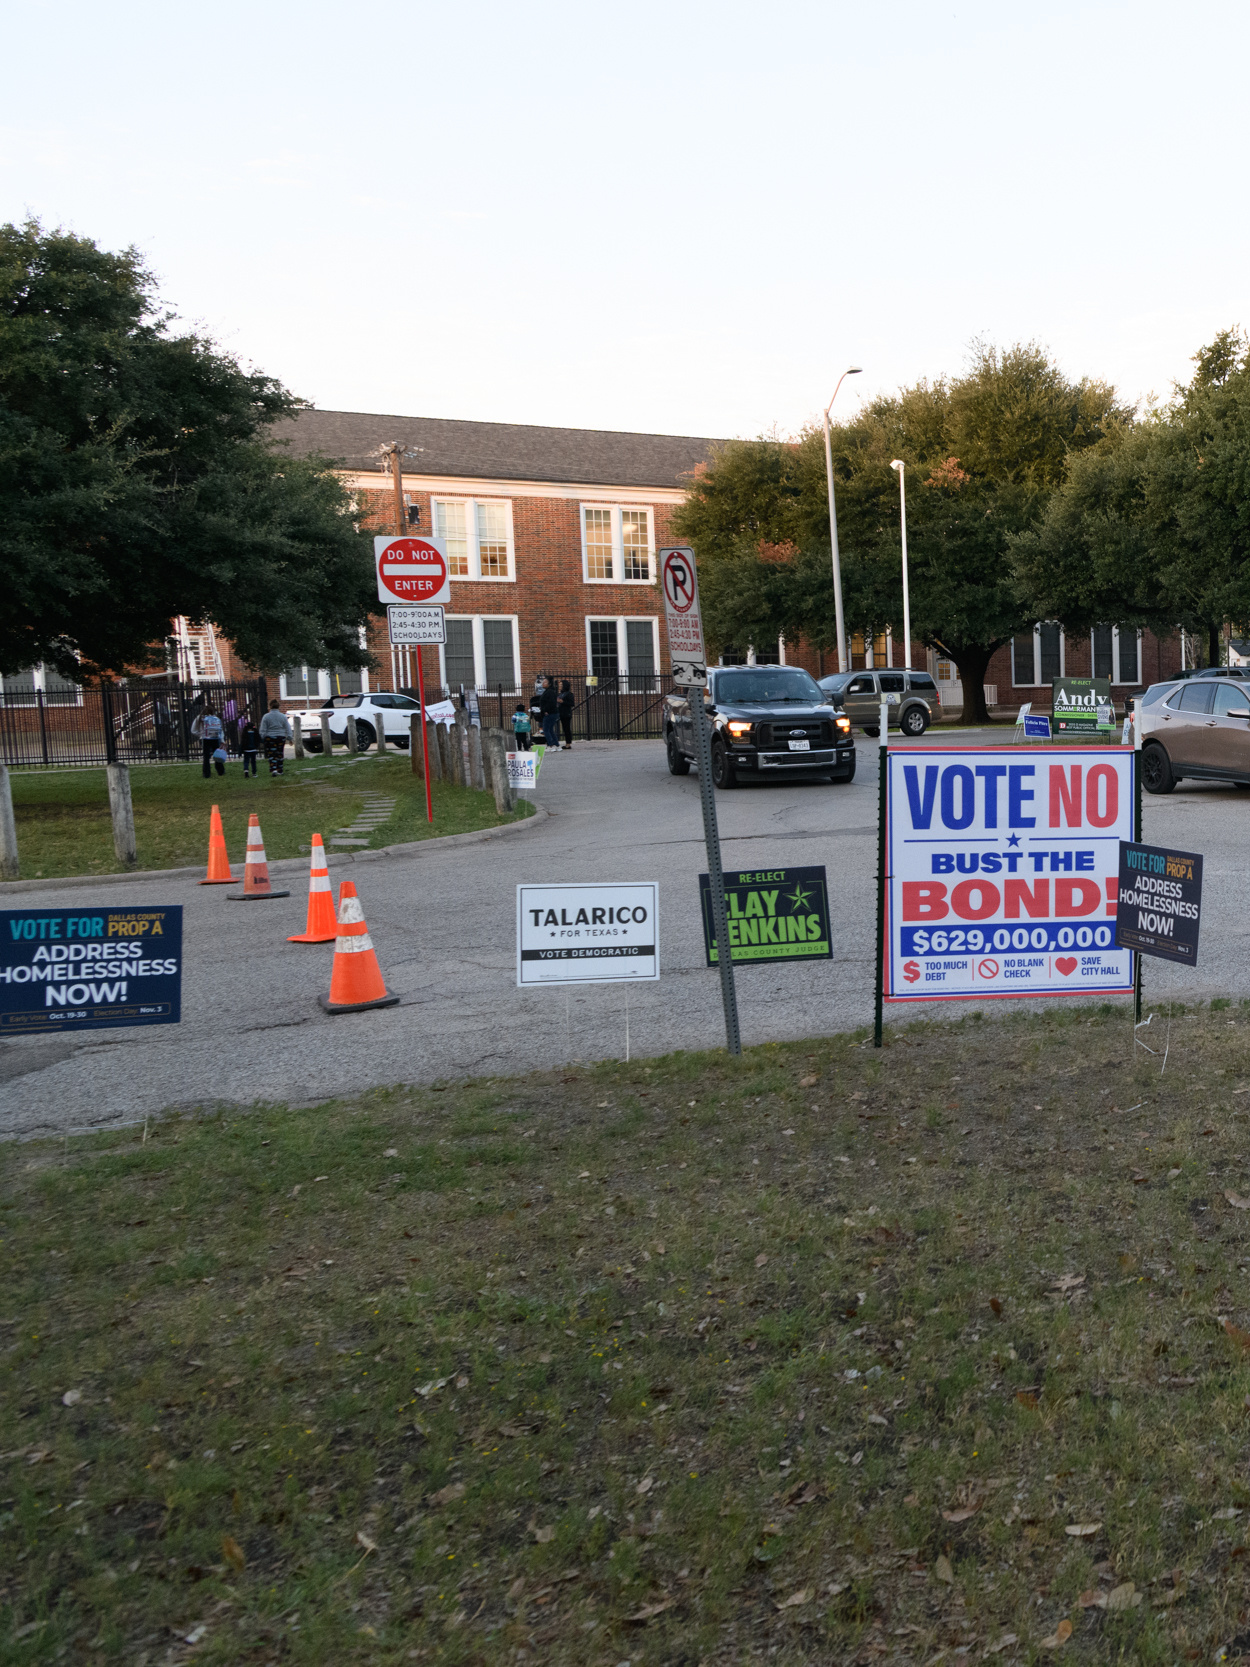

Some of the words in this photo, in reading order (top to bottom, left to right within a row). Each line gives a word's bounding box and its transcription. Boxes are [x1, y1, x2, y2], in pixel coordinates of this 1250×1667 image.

[387, 550, 404, 560] DO
[412, 550, 435, 560] NOT
[395, 581, 433, 590] ENTER
[392, 621, 426, 629] 2:45-4:30
[429, 621, 442, 629] P.M.
[691, 619, 698, 629] AM
[692, 630, 700, 640] PM
[507, 760, 526, 769] PAULA
[903, 764, 1037, 830] VOTE
[1048, 763, 1119, 828] NO
[931, 852, 1023, 874] BUST
[1028, 851, 1095, 872] THE
[1126, 850, 1147, 871] VOTE
[1149, 854, 1166, 875] FOR
[740, 871, 785, 883] RE-ELECT
[1167, 863, 1186, 878] PROP
[1187, 866, 1193, 880] A
[1134, 875, 1183, 898] ADDRESS
[902, 877, 1119, 922] BOND!
[1119, 888, 1199, 920] HOMELESSNESS
[109, 914, 136, 922] DALLAS
[137, 913, 165, 921] COUNTY
[529, 906, 648, 927] TALARICO
[10, 918, 61, 940] VOTE
[67, 917, 104, 938] FOR
[108, 921, 149, 937] PROP
[151, 921, 163, 935] A
[1138, 911, 1174, 937] NOW!
[560, 930, 580, 938] FOR
[585, 929, 618, 937] TEXAS
[712, 914, 821, 947] ENKINS
[912, 926, 1111, 954] $629,000,000
[32, 942, 143, 963] ADDRESS
[539, 950, 568, 959] VOTE
[572, 947, 639, 957] DEMOCRATIC
[713, 949, 749, 959] DLAS
[753, 948, 790, 956] COUNTY
[795, 945, 825, 953] JUDGE
[925, 961, 942, 971] TOO
[943, 961, 968, 971] MUCH
[1004, 960, 1016, 968] NO
[1018, 959, 1044, 968] BLANK
[1081, 957, 1102, 966] SAVE
[925, 972, 946, 981] DEBT
[1004, 970, 1031, 979] CHECK
[1081, 967, 1099, 976] CITY
[1100, 966, 1120, 976] HALL
[45, 981, 128, 1006] NOW!
[9, 1015, 29, 1023] Early
[67, 1011, 87, 1019] 19-30
